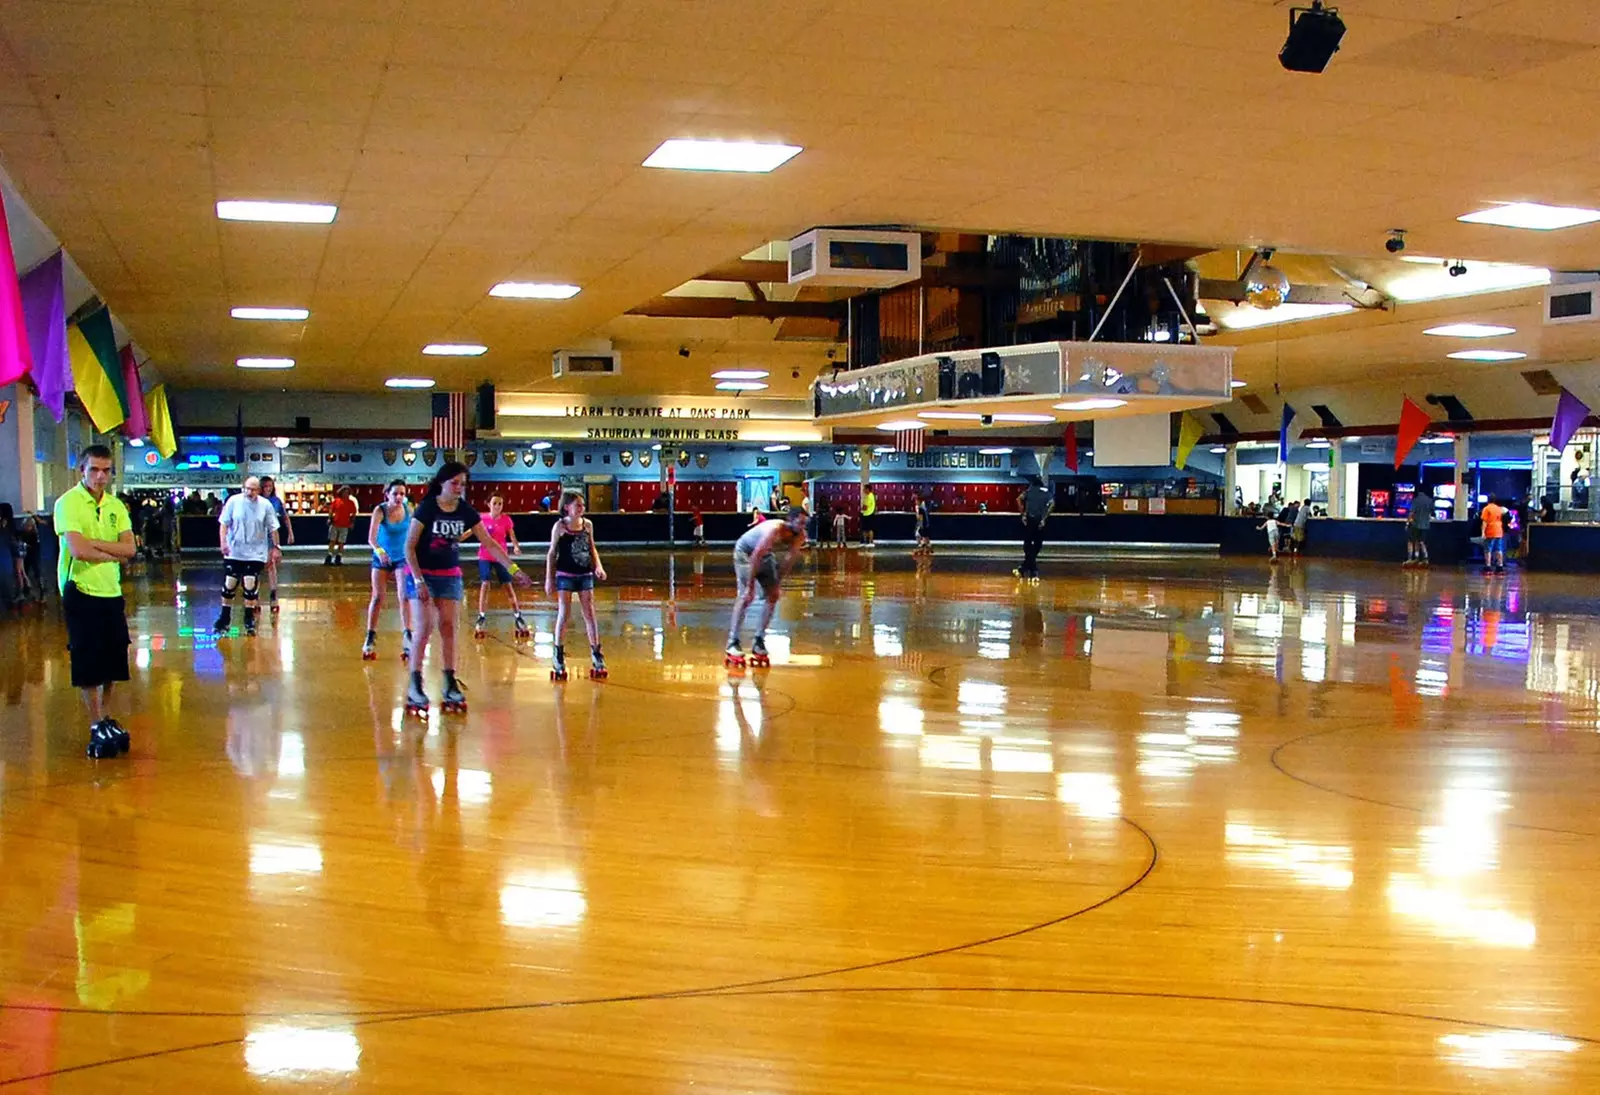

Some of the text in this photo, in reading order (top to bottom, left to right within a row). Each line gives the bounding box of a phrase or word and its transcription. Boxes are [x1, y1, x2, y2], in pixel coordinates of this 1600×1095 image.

[566, 406, 751, 419] LEARN TO SKATE AT OAKS PARK
[587, 428, 739, 440] SATURDAY MORNING CLASS
